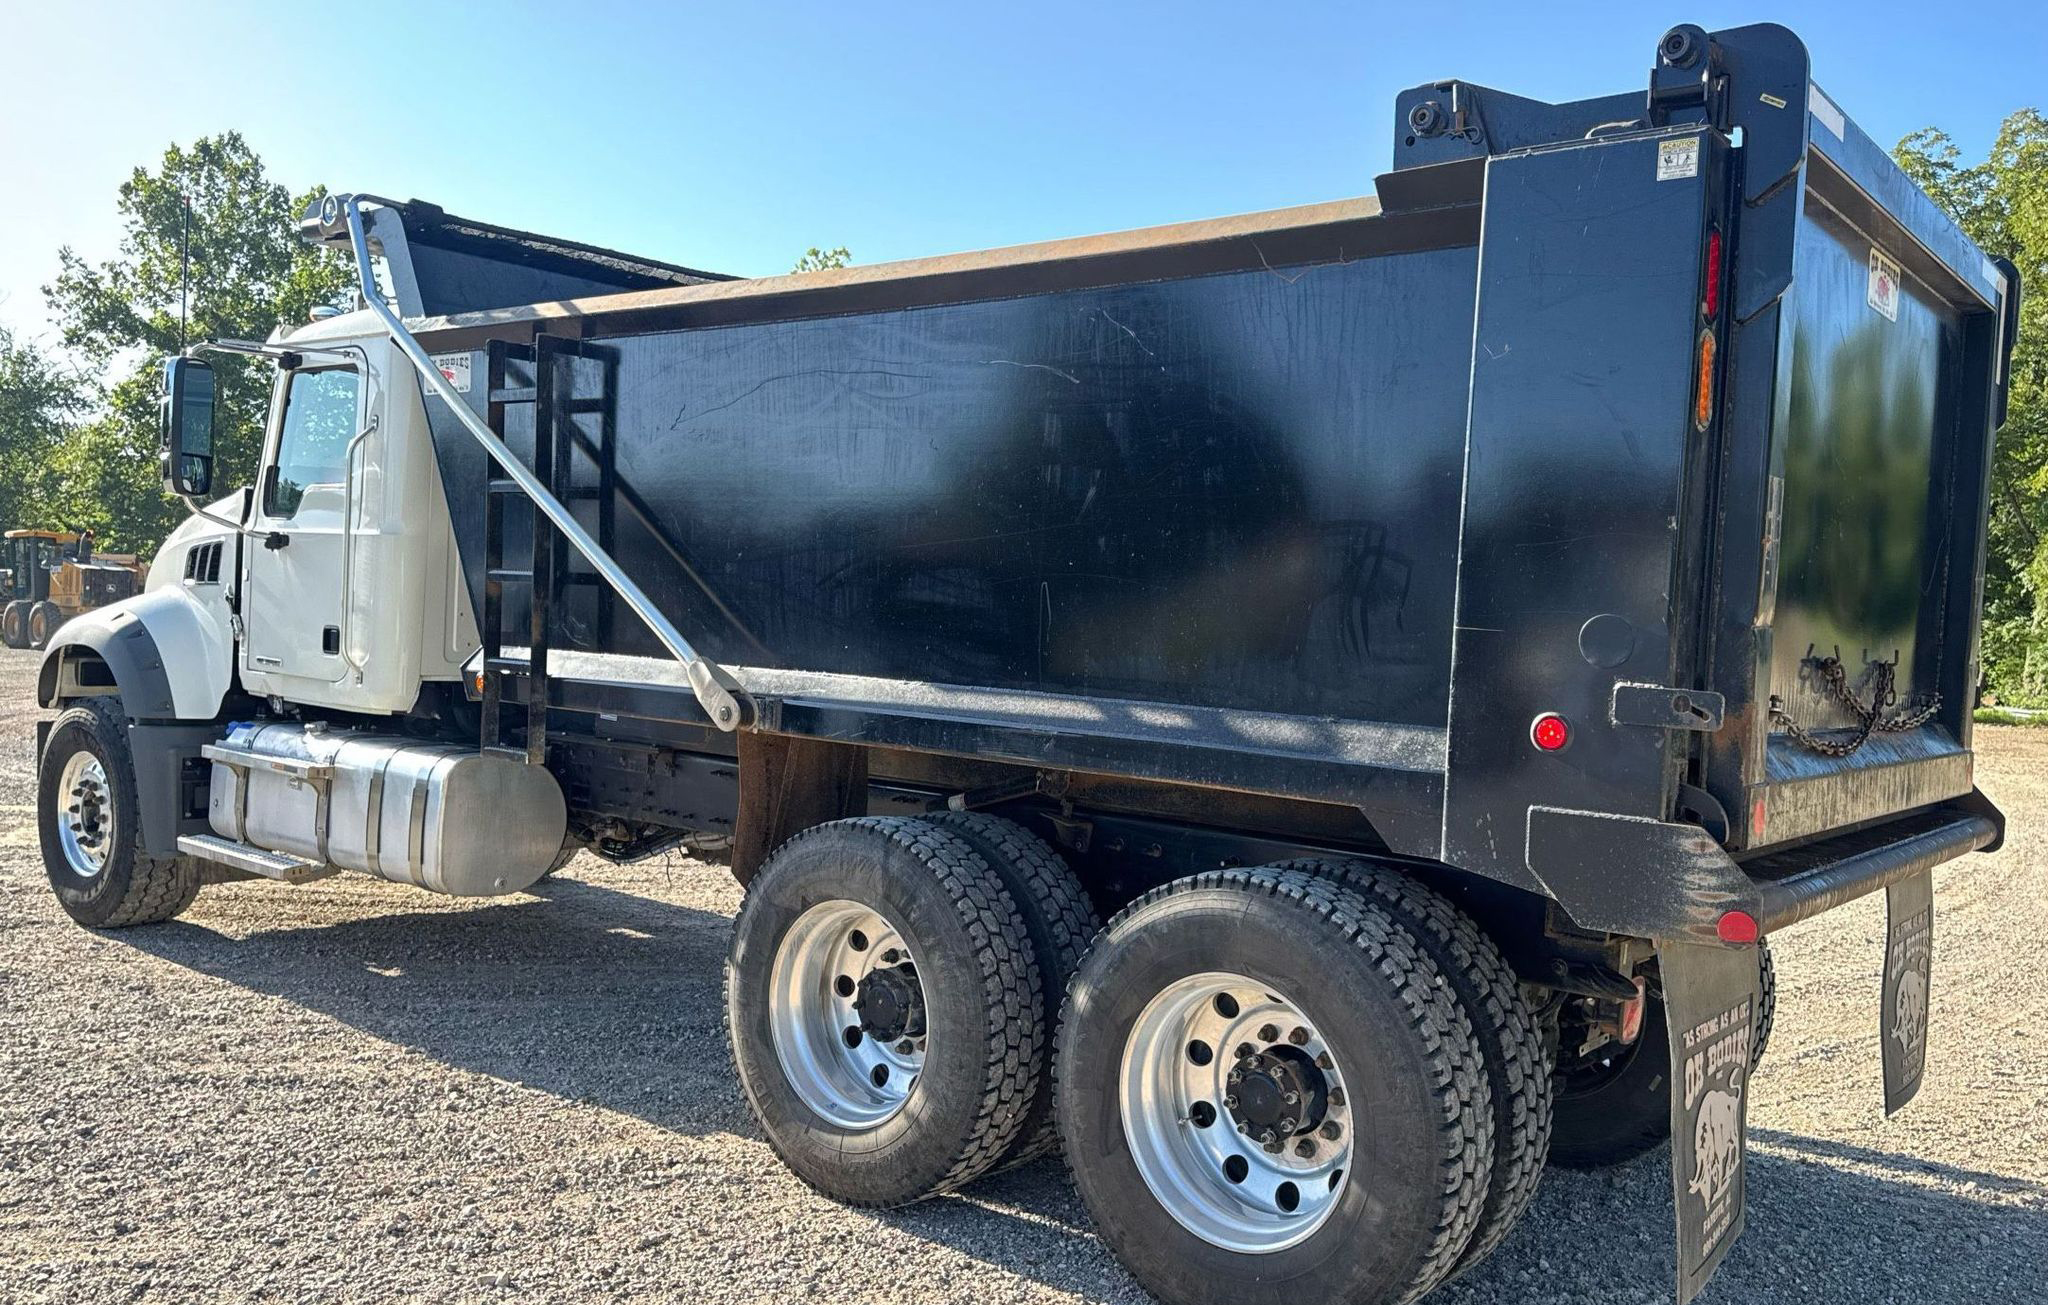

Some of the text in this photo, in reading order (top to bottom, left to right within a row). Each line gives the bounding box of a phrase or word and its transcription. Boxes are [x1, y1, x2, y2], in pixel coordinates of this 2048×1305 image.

[1668, 140, 1696, 149] CAUTION
[440, 356, 469, 369] BODIES
[1720, 1011, 1729, 1031] AS
[1707, 1024, 1750, 1077] BODIES
